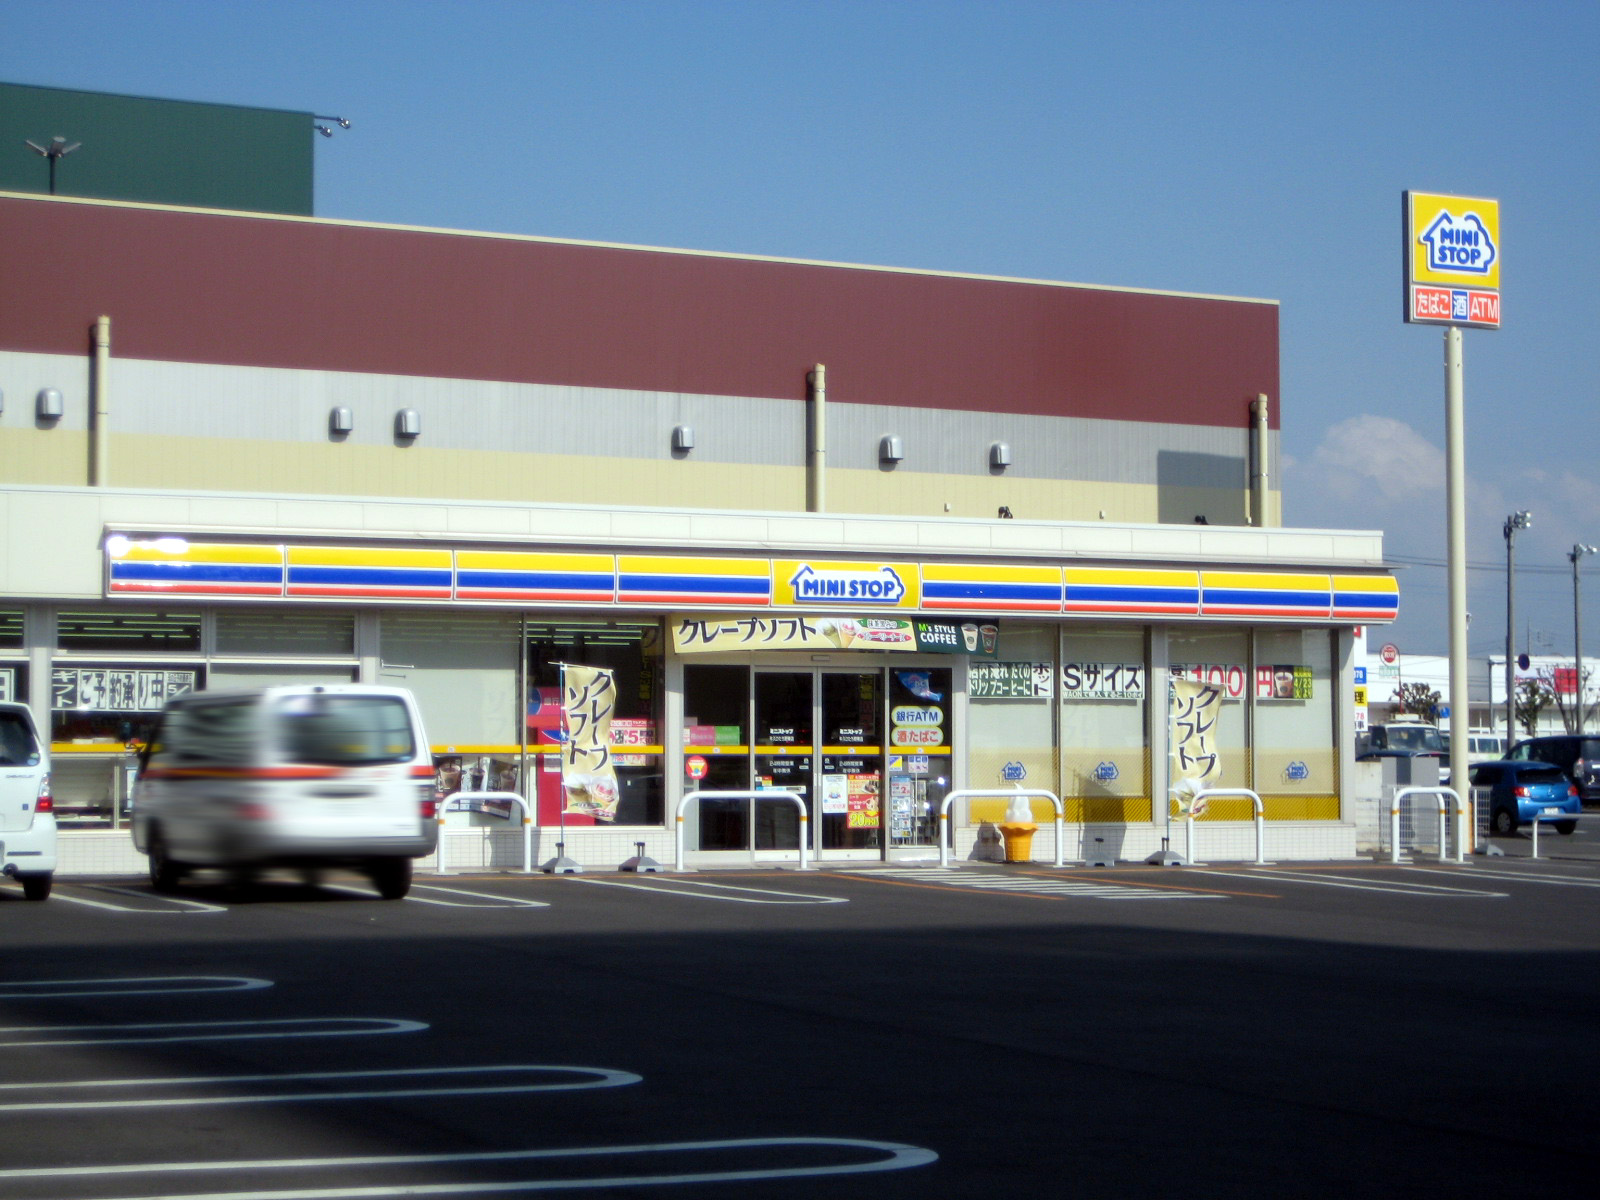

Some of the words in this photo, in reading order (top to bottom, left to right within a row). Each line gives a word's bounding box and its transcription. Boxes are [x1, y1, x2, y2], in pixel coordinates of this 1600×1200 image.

[1440, 228, 1479, 246] MINI
[1438, 245, 1481, 265] STOP
[1453, 295, 1467, 316] 酒
[1470, 297, 1498, 319] ATM
[803, 579, 846, 596] MINI
[849, 580, 895, 597] STOP
[679, 617, 817, 645] クレープソフト
[920, 632, 957, 645] COFFEE
[934, 625, 956, 634] STYLE
[52, 671, 77, 708] ギフト
[1033, 664, 1049, 695] ホット
[1063, 664, 1141, 690] Sサイズ
[569, 686, 588, 765] ソフト
[896, 711, 938, 722] 銀行ATM
[1176, 697, 1194, 770] ソフト
[1196, 686, 1220, 779] クレープ
